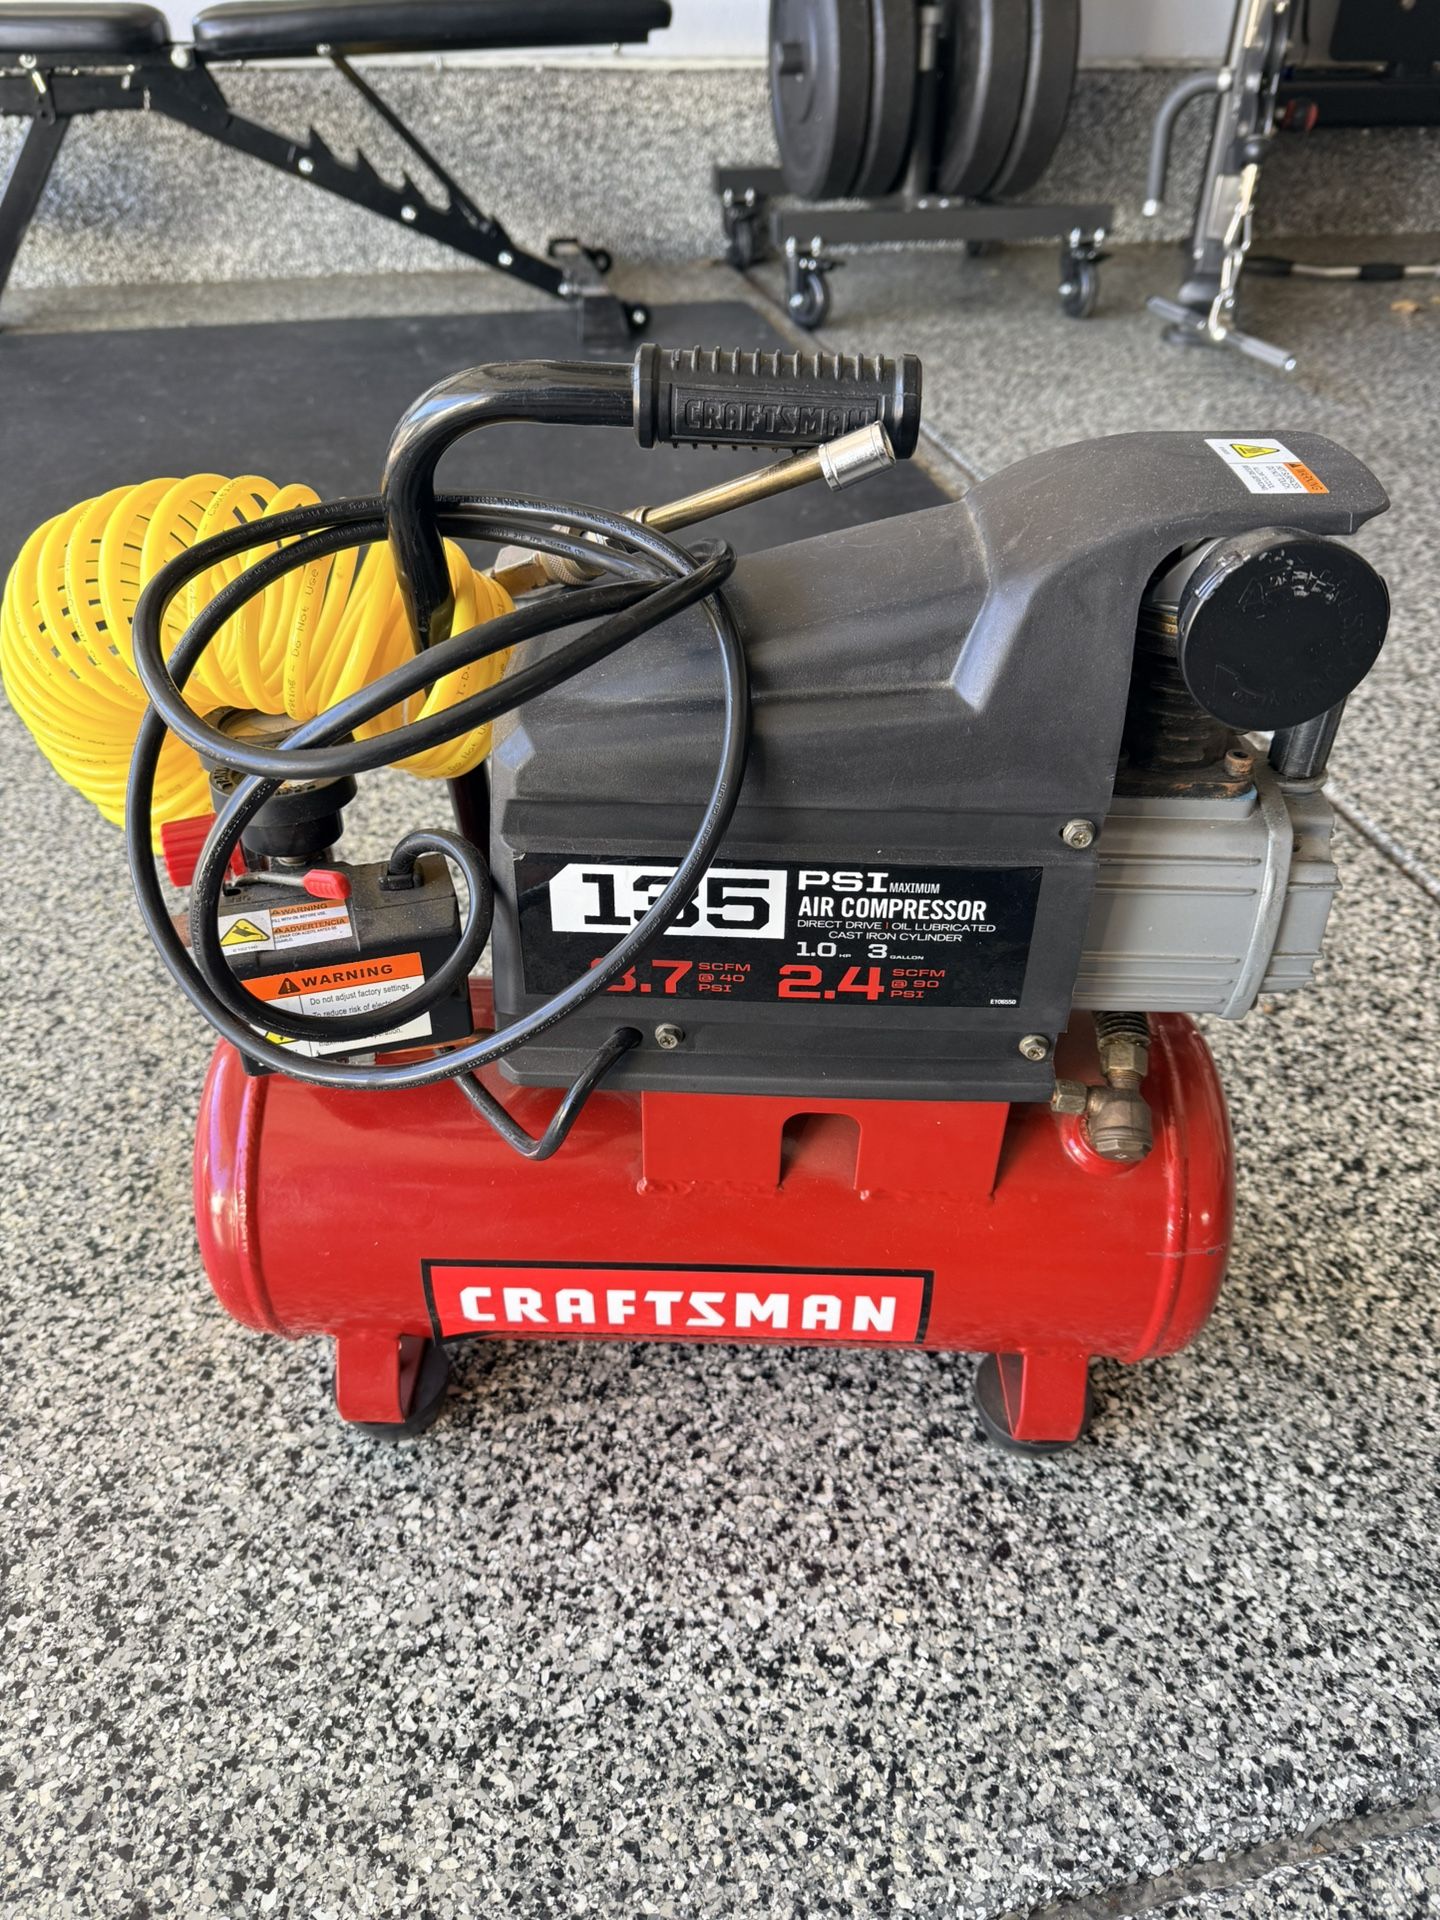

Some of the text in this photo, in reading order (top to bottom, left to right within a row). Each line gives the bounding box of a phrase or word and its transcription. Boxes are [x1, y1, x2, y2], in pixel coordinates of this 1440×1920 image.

[684, 399, 876, 436] CRAFTSMAN
[305, 568, 319, 596] Use
[798, 870, 940, 894] PSI MAXIMUM
[280, 903, 328, 915] WARNING
[799, 896, 987, 921] AIR COMPRESSOR
[284, 918, 345, 933] ADVERTENCIA
[797, 920, 996, 933] DIRECT DRIVE OIL LUBRICATED
[829, 931, 963, 942] CAST IRON CYLINDER
[796, 942, 837, 957] 1.0
[867, 943, 888, 959] 3
[698, 963, 751, 972] SCFM
[892, 968, 946, 977] SCFM
[301, 964, 393, 987] WARNING
[698, 973, 745, 983] @ 40
[778, 964, 885, 1001] 2.4
[698, 984, 732, 993] PSI
[891, 979, 939, 989] @ 90
[310, 982, 412, 1006] Do not adjust factory settings.
[890, 990, 925, 999] PSI
[323, 1006, 348, 1017] reduce
[349, 1003, 362, 1013] risk
[363, 1002, 371, 1011] of
[459, 1286, 897, 1332] CRAFTSMAN
